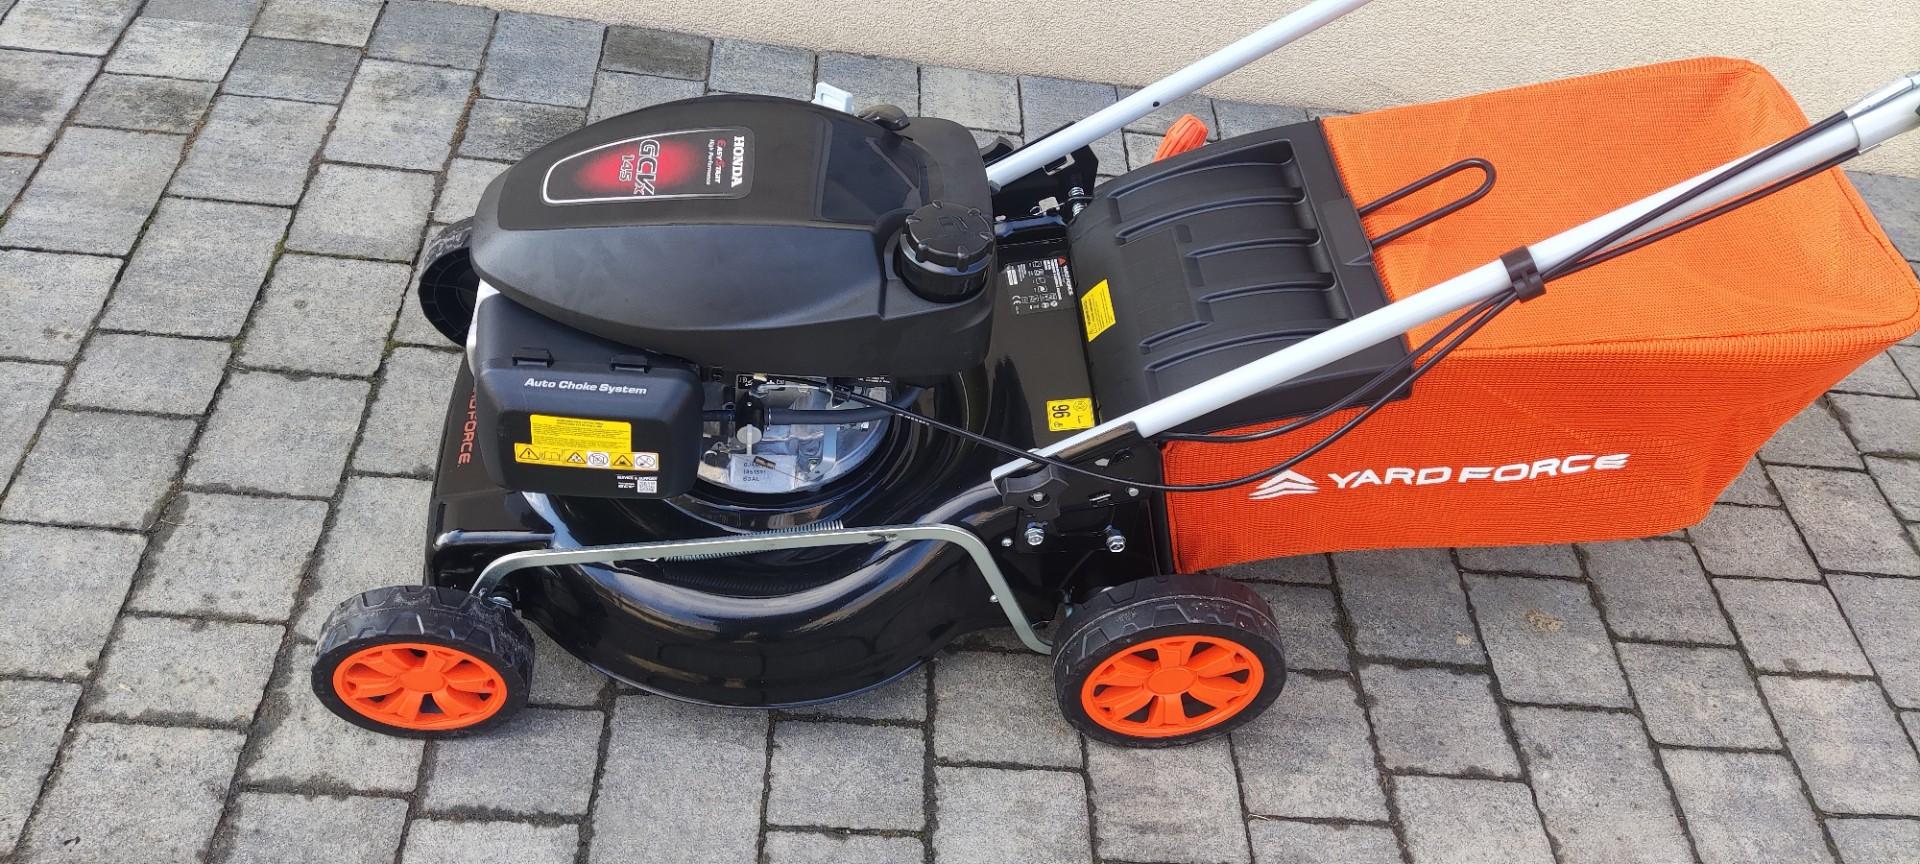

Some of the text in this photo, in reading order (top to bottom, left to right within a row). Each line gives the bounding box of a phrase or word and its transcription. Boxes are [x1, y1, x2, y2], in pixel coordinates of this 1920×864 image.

[618, 154, 636, 183] 145
[731, 135, 745, 188] HONDA
[524, 377, 647, 395] Auto Choke System
[1052, 404, 1071, 419] 96
[1327, 453, 1631, 489] YARD FORCE
